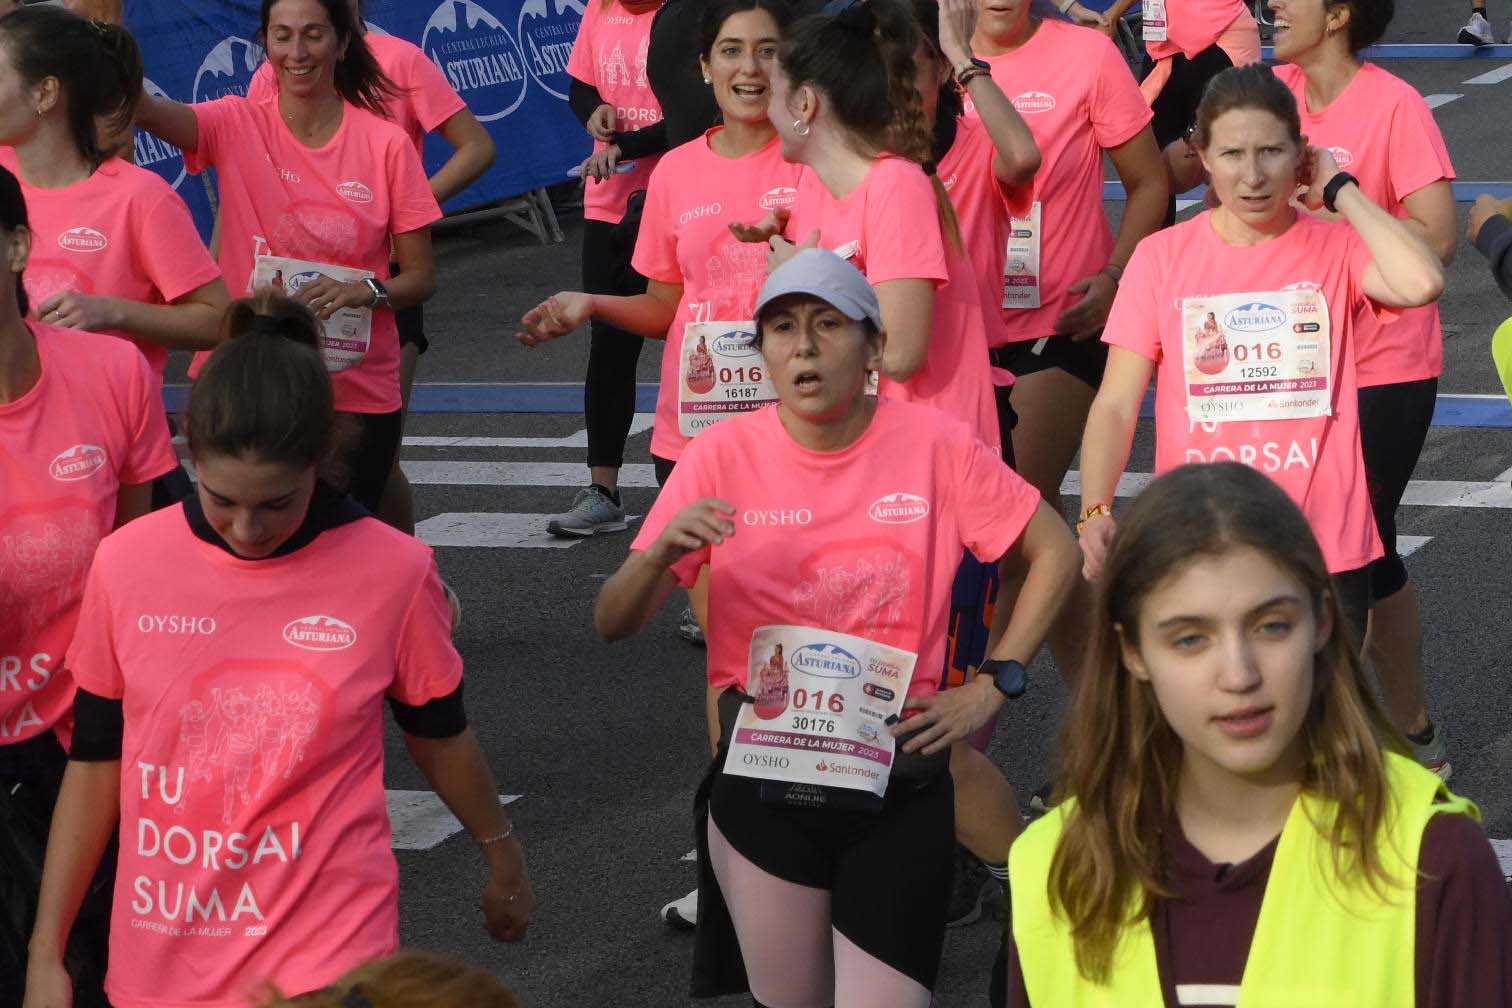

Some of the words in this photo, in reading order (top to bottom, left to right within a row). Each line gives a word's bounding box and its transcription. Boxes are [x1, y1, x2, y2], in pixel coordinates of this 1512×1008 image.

[680, 202, 721, 224] OYSHO
[61, 236, 104, 247] ASTURIANA
[1229, 314, 1282, 327] ASTURIANA
[1233, 342, 1282, 362] 016
[719, 367, 762, 383] 016
[1240, 366, 1278, 378] 12592
[725, 388, 758, 398] 16187
[1203, 384, 1242, 393] CARRERA
[1244, 384, 1255, 392] DE
[1257, 383, 1268, 391] LA
[1269, 382, 1297, 390] MUJER
[693, 403, 727, 411] CARRERA
[740, 402, 750, 410] LA
[1279, 398, 1319, 408] Santander
[55, 456, 104, 477] ASTURIANA
[743, 508, 812, 527] OYSHO
[873, 504, 926, 517] ASTURIANA
[137, 615, 217, 635] OYSHO
[288, 625, 352, 645] ASTURIANA
[795, 654, 855, 676] ASTURIANA
[867, 663, 900, 680] SUMA
[793, 688, 845, 714] 016
[792, 716, 835, 733] 30176
[751, 733, 791, 746] CARRERA
[794, 737, 807, 746] DE
[808, 738, 820, 747] LA
[822, 741, 856, 752] MUJER
[857, 747, 880, 759] 2023
[743, 753, 790, 768] OYSHO
[829, 762, 880, 780] Santander
[138, 761, 185, 805] TU
[131, 875, 265, 923] SUMA
[131, 919, 168, 934] CARRERA
[168, 927, 181, 936] DE
[183, 927, 197, 937] LA
[199, 928, 232, 937] MUJER
